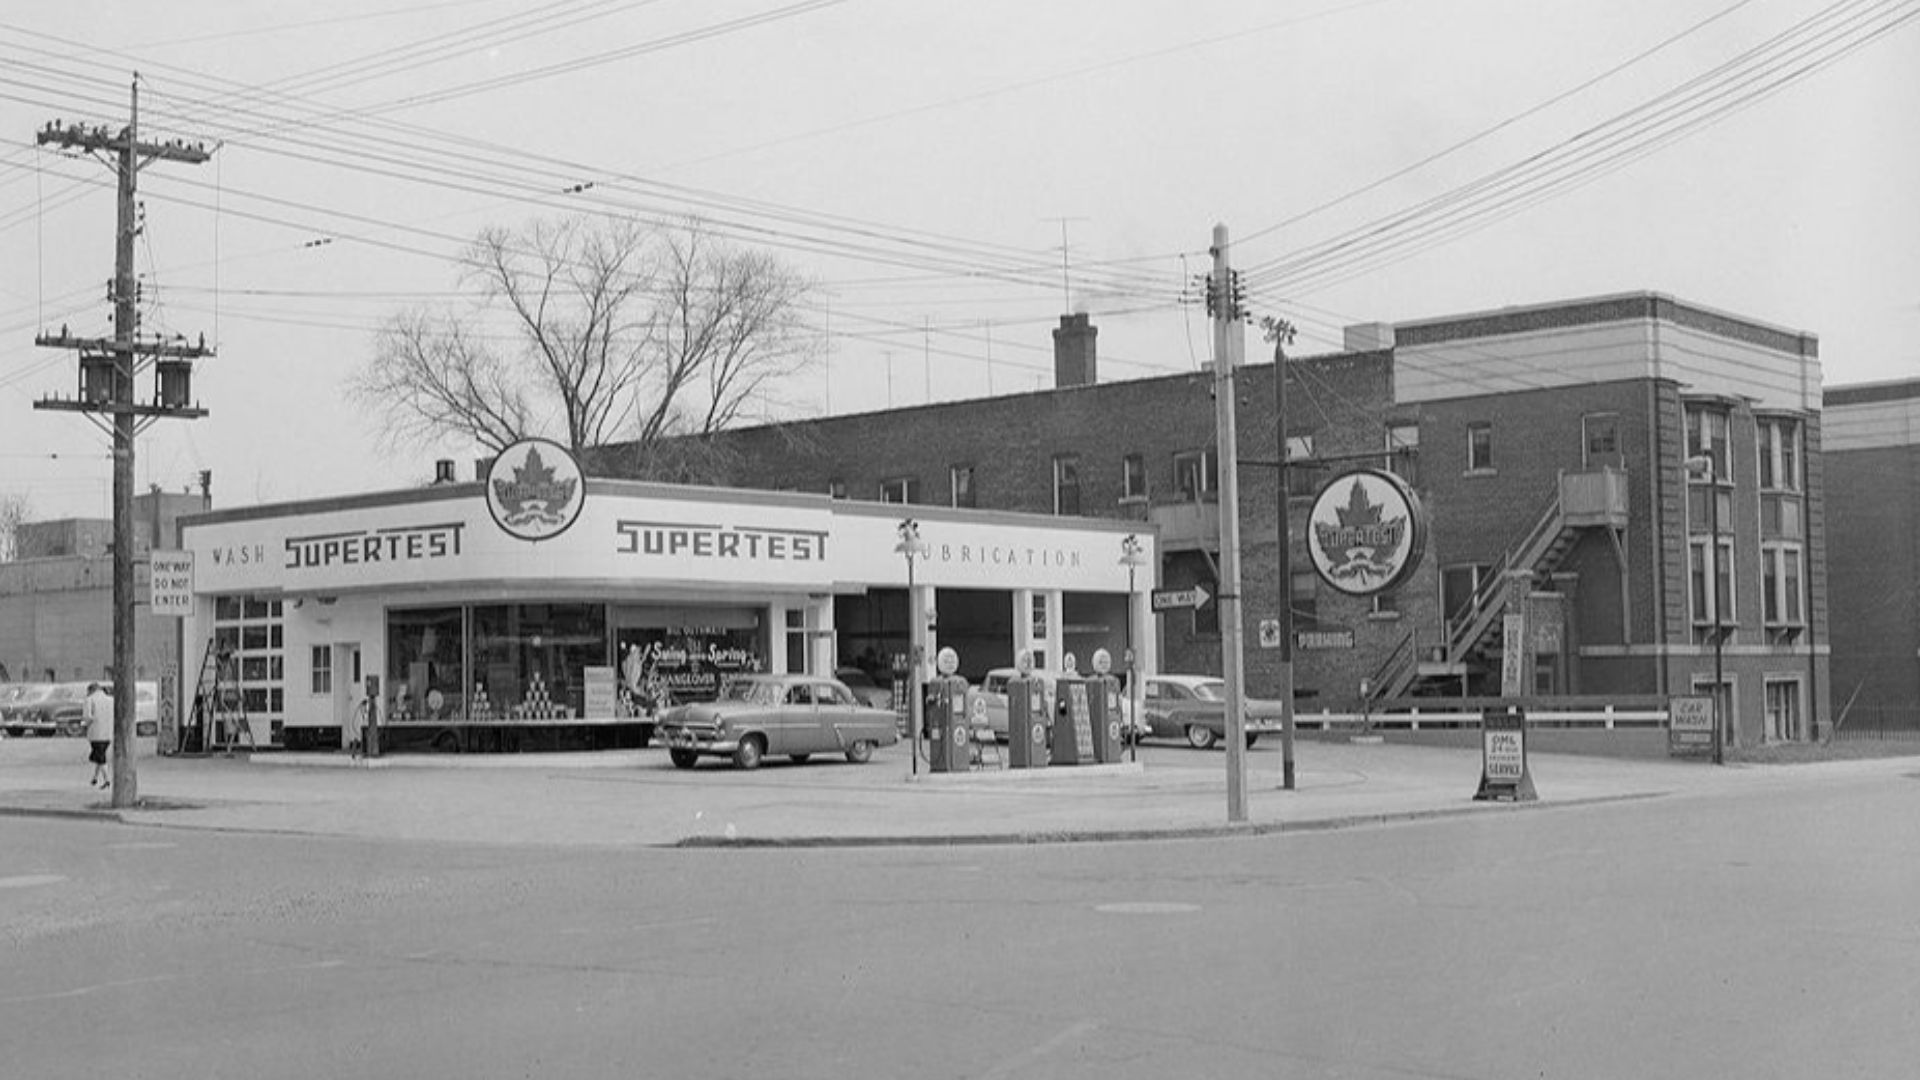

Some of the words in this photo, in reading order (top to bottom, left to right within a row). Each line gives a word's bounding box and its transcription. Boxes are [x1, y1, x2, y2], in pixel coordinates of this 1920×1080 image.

[285, 521, 466, 569] SUPERTEST
[617, 519, 830, 561] SUPERTEST
[213, 545, 265, 567] WASH
[920, 543, 1081, 567] UBRICATION
[153, 561, 170, 572] ONE
[171, 561, 191, 572] WAY
[155, 578, 168, 589] DO
[172, 578, 189, 589] NOT
[155, 595, 189, 606] ENTER
[1298, 630, 1353, 649] PARKING
[651, 641, 686, 665] Swing
[708, 643, 746, 667] Spring
[1679, 702, 1704, 713] CAR
[1675, 714, 1708, 726] WASH
